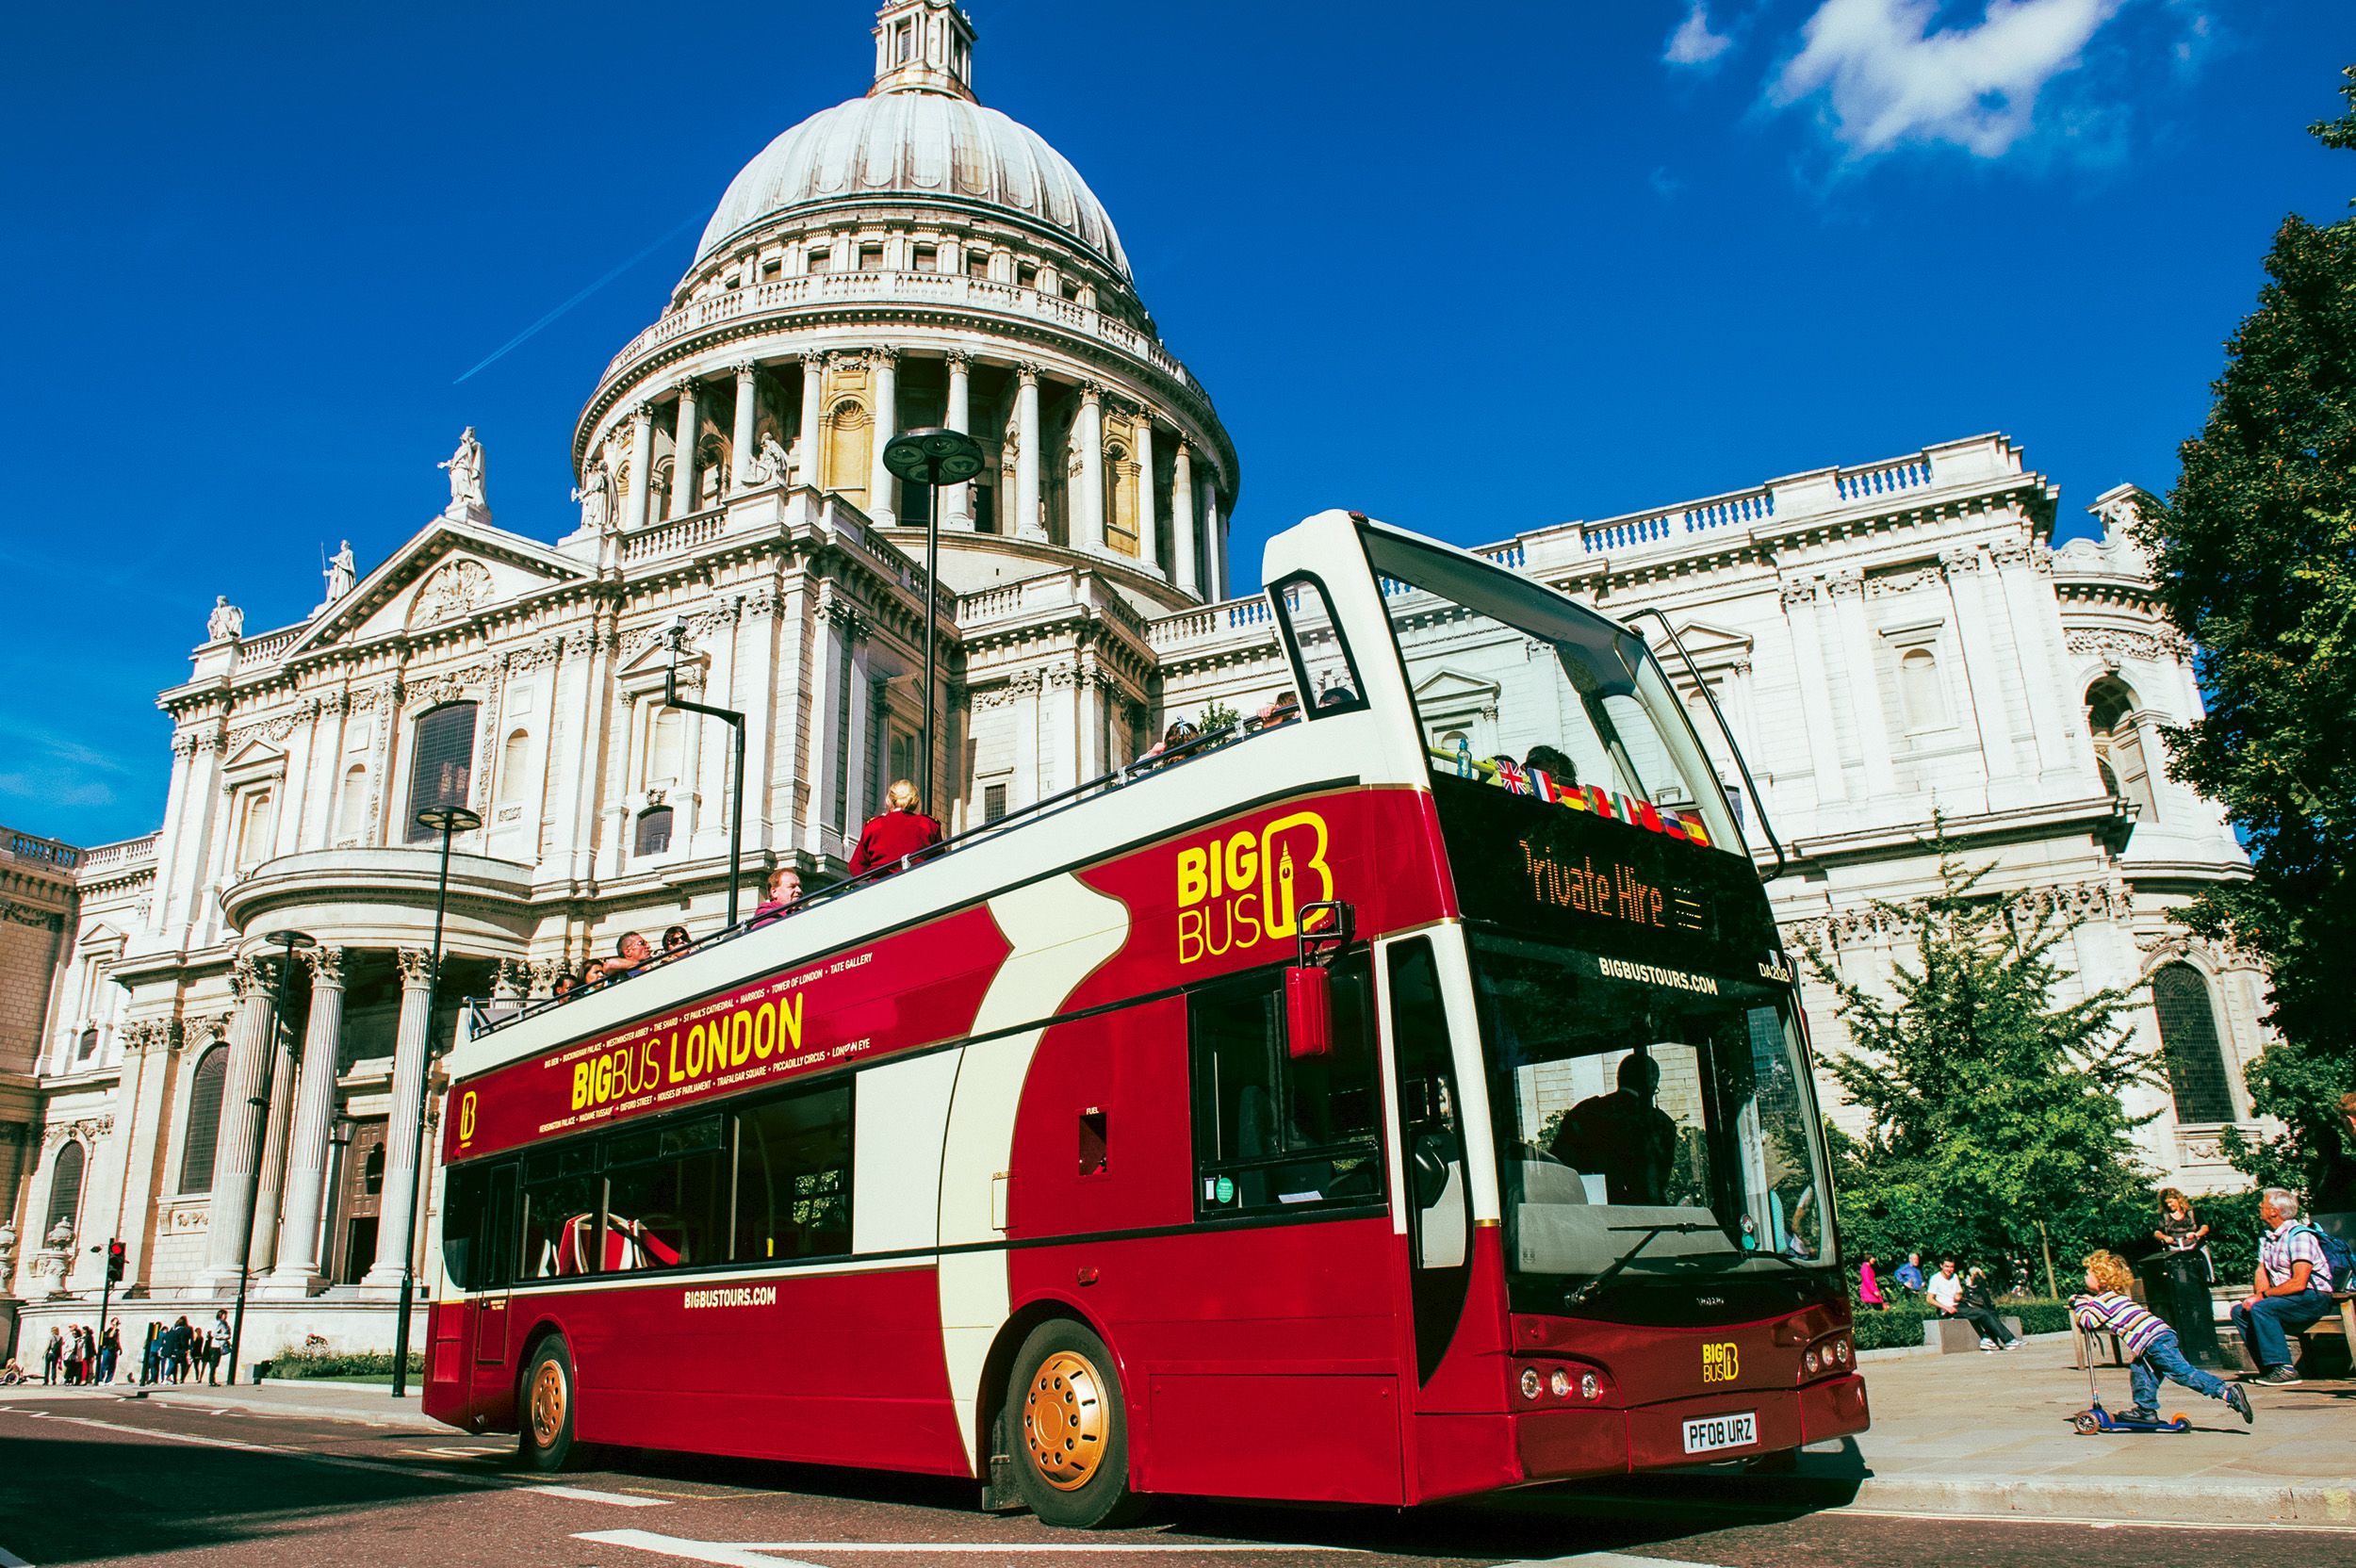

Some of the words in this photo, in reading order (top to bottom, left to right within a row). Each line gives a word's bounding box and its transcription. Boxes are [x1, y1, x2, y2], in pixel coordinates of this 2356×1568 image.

[1177, 830, 1258, 907] BIG
[1615, 863, 1665, 927] Hire
[1178, 893, 1261, 964] BUS
[1598, 956, 1719, 996] BIGBUSTOURS.COM
[1758, 962, 1791, 982] DA208
[586, 1042, 602, 1054] PALACE
[606, 1032, 635, 1048] WESTMINSTER
[634, 1026, 649, 1038] ABBEY
[653, 1022, 663, 1032] THE
[663, 1017, 679, 1029] SHARD
[683, 1013, 690, 1022] ST
[706, 999, 734, 1015] CATHEDRAL
[740, 988, 765, 1004] HARRODS
[771, 980, 790, 993] TOWER
[791, 976, 799, 988] OF
[799, 969, 823, 985] LONDON
[830, 961, 844, 974] TATE
[845, 953, 873, 970] GALLERY
[669, 991, 803, 1084] LONDON
[561, 1116, 576, 1127] PALACE
[579, 1110, 596, 1122] MADAME
[619, 1100, 637, 1111] OXFORD
[637, 1095, 653, 1107] STREET
[657, 1089, 675, 1102] HOUSES
[675, 1087, 682, 1097] OF
[681, 1080, 712, 1095] PARLIAMENT
[716, 1070, 745, 1086] TRAFALGAR
[745, 1066, 767, 1079] SQUARE
[773, 1055, 804, 1072] PICCADILLY
[804, 1051, 826, 1065] CIRCUS
[859, 1037, 870, 1051] EYE
[1086, 1106, 1099, 1115] FUEL
[683, 1286, 777, 1309] BIGBUSTOURS.COM
[1702, 1344, 1723, 1364] BIG
[1703, 1364, 1724, 1382] BUS
[1689, 1421, 1725, 1448] PF08
[1726, 1418, 1752, 1443] URZ
